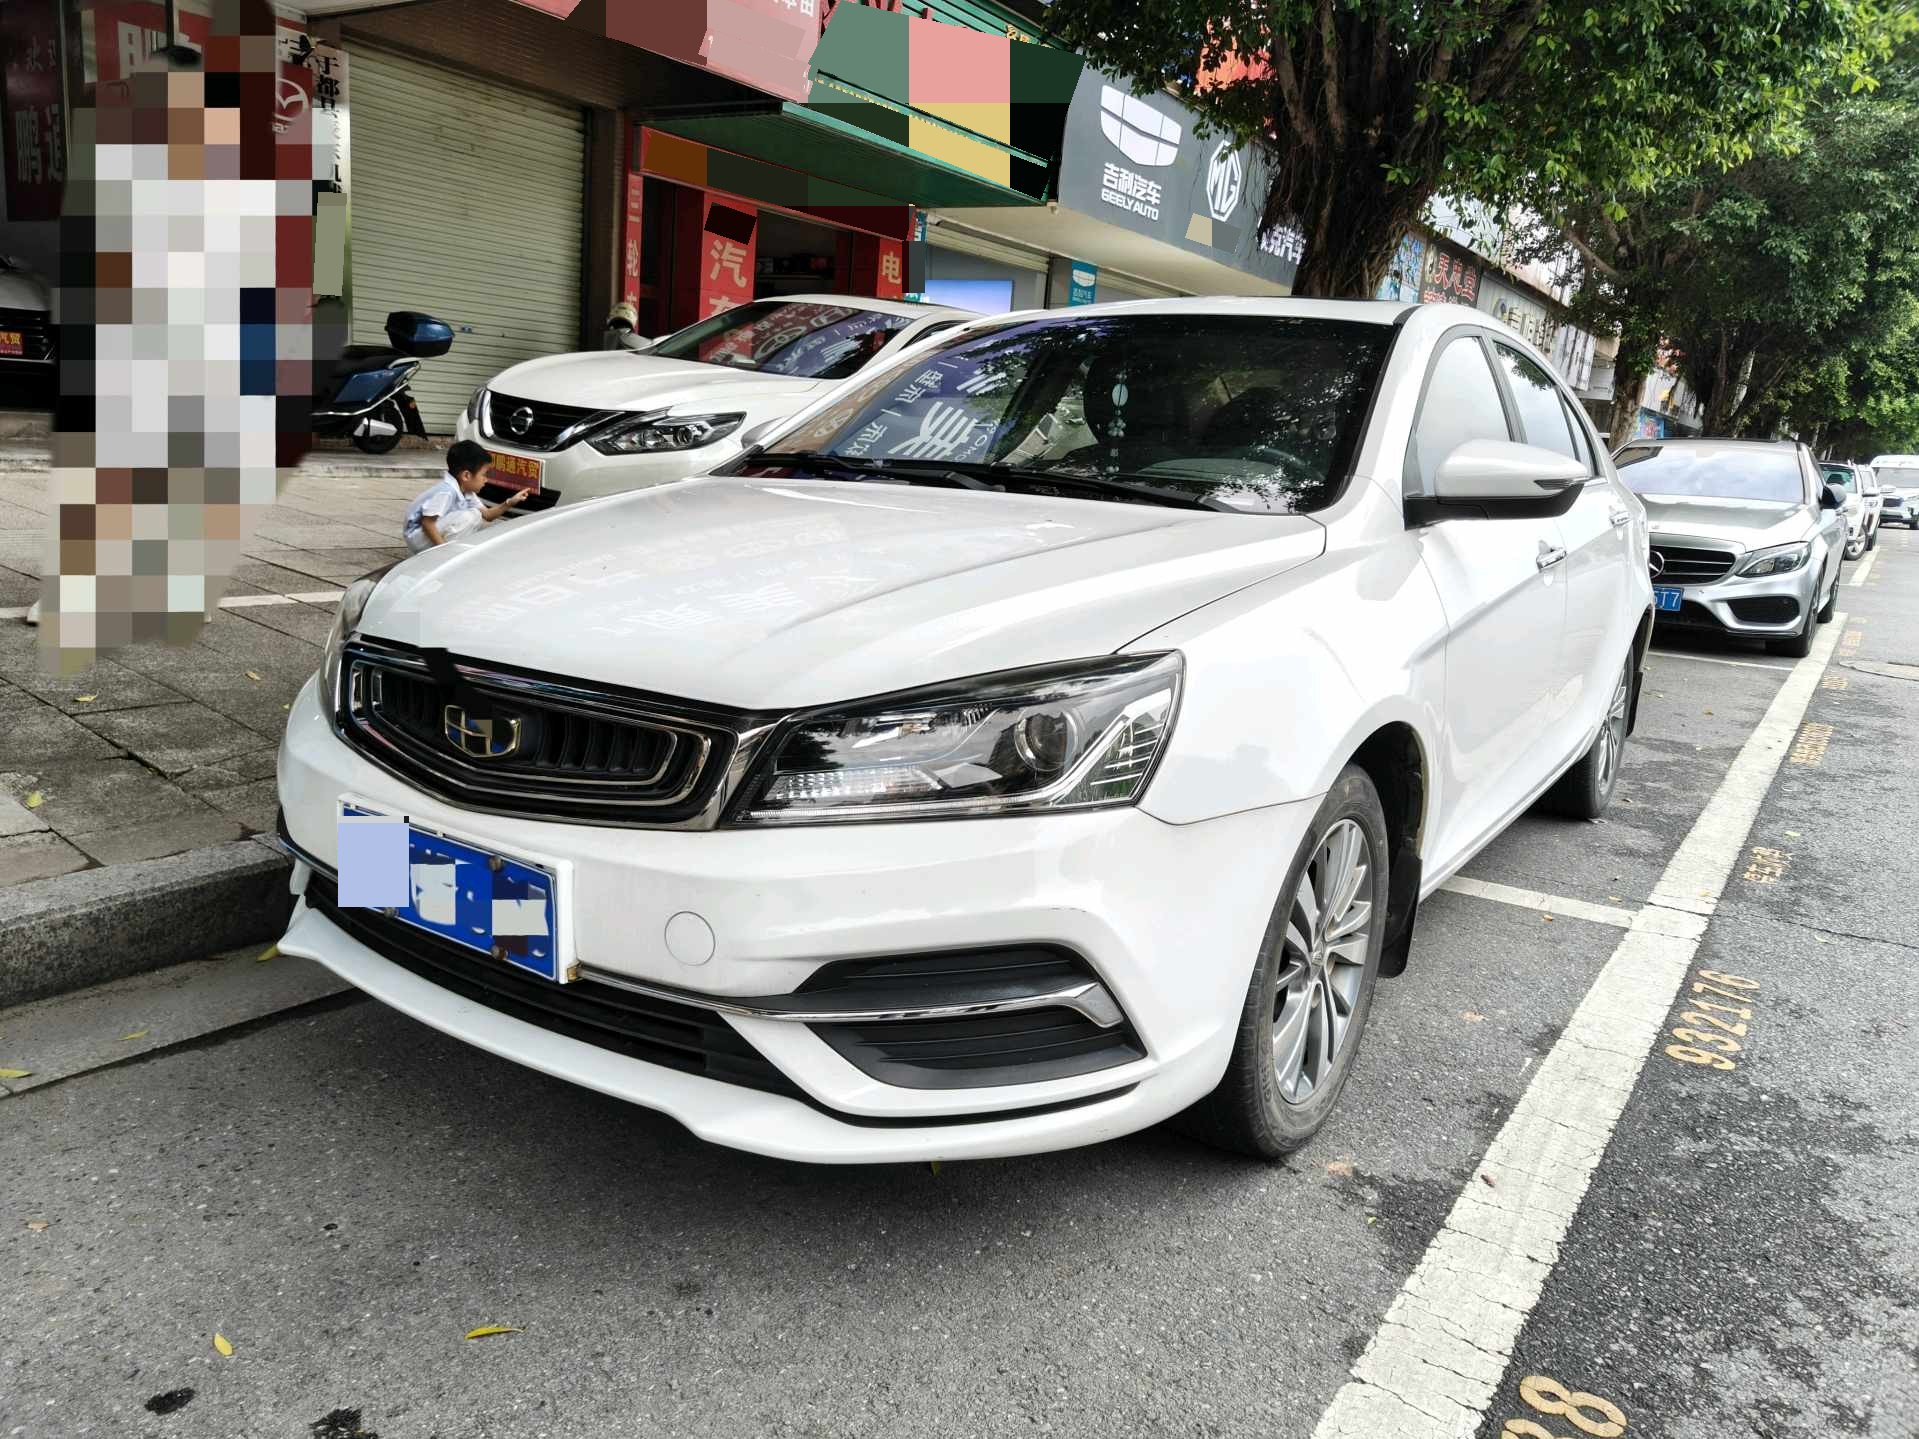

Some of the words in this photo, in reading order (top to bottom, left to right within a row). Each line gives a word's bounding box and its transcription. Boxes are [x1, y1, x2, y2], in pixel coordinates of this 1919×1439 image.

[1101, 187, 1134, 210] GEELY
[1132, 200, 1160, 221] AUTO
[1103, 162, 1162, 206] 吉利汽车
[1502, 1375, 1628, 1439] 8
